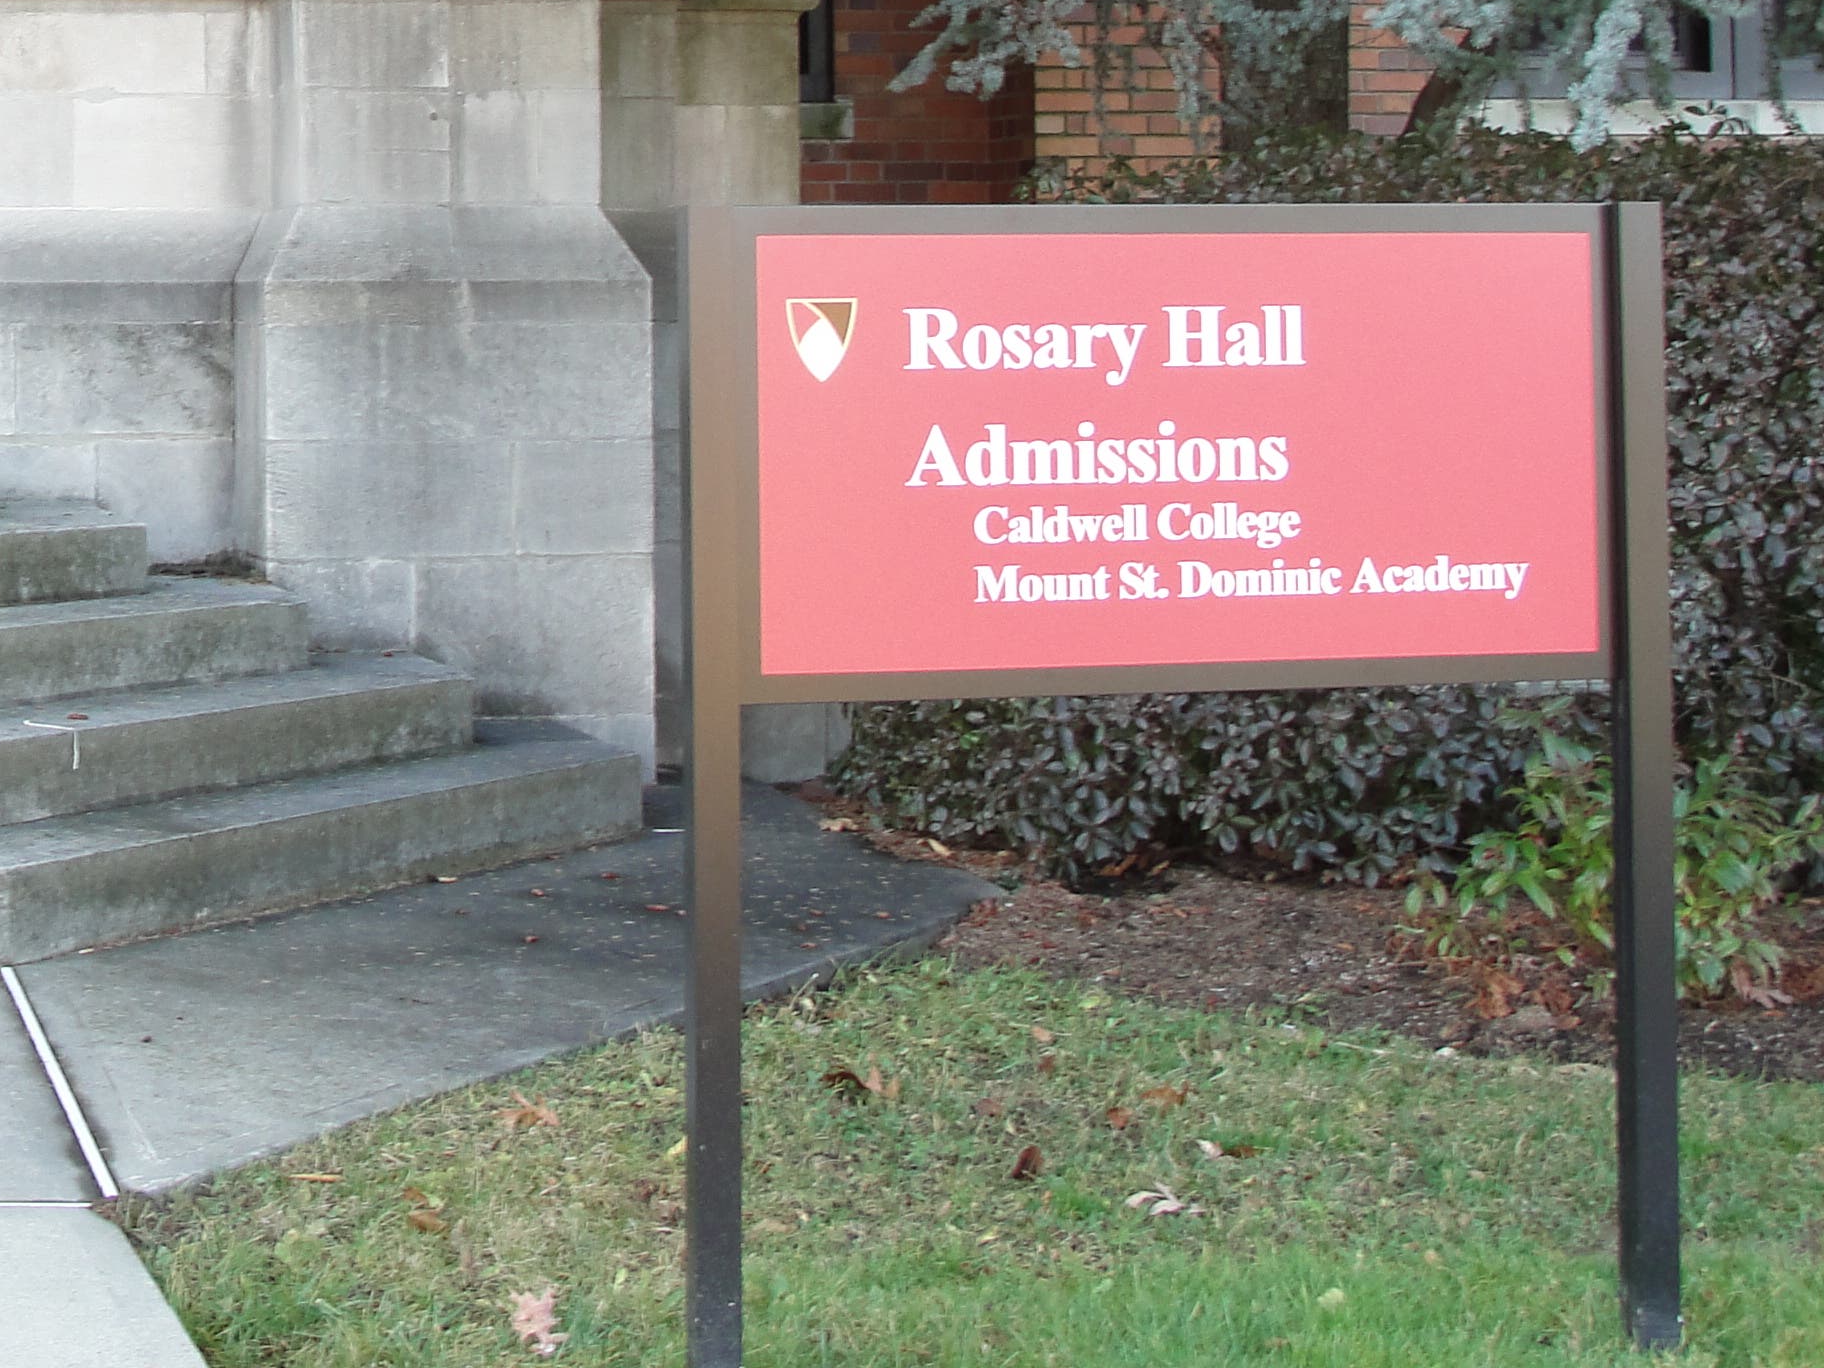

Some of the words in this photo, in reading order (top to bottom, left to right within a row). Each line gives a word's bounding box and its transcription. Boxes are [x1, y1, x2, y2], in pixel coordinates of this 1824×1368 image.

[902, 306, 1147, 386] Rosary
[1162, 304, 1307, 370] Hall
[904, 420, 1289, 487] Admissions
[973, 503, 1150, 545] Caldwell
[1157, 501, 1301, 550] College
[973, 564, 1111, 603] Mount
[1119, 562, 1170, 600] St.
[1177, 558, 1342, 598] Dominic
[1349, 555, 1530, 600] Academy
